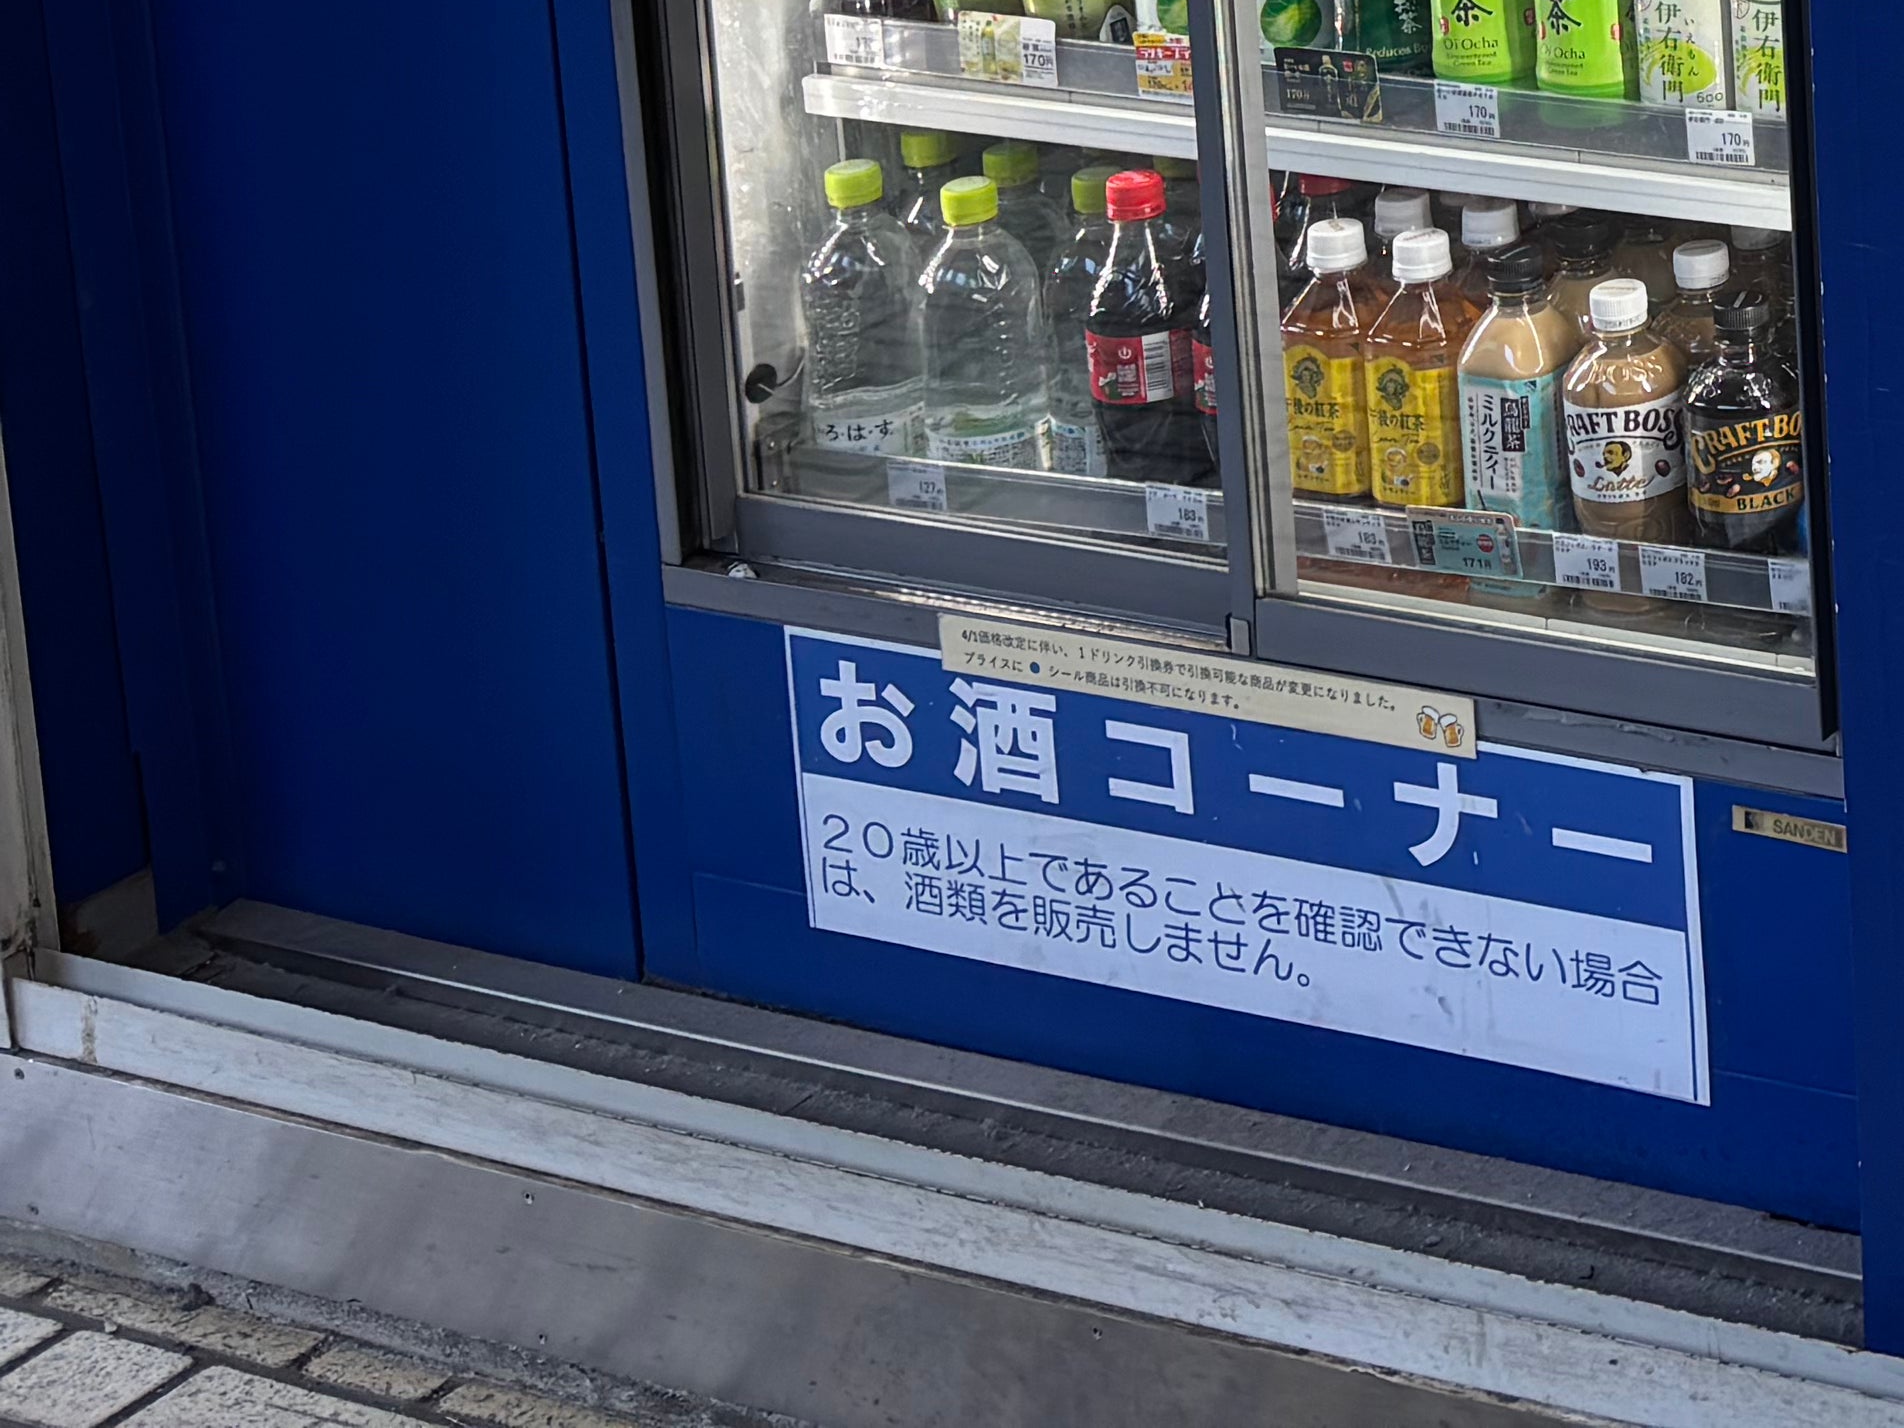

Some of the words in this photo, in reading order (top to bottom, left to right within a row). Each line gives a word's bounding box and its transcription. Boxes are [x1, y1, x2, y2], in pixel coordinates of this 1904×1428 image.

[1653, 1, 1685, 106] 伊右衛門
[1736, 490, 1798, 512] BLACK
[964, 650, 1024, 675] プライスに
[817, 659, 1654, 869] お酒コーナー
[1772, 817, 1838, 845] SANDEN
[821, 856, 1314, 989] は、酒類を販売しません。
